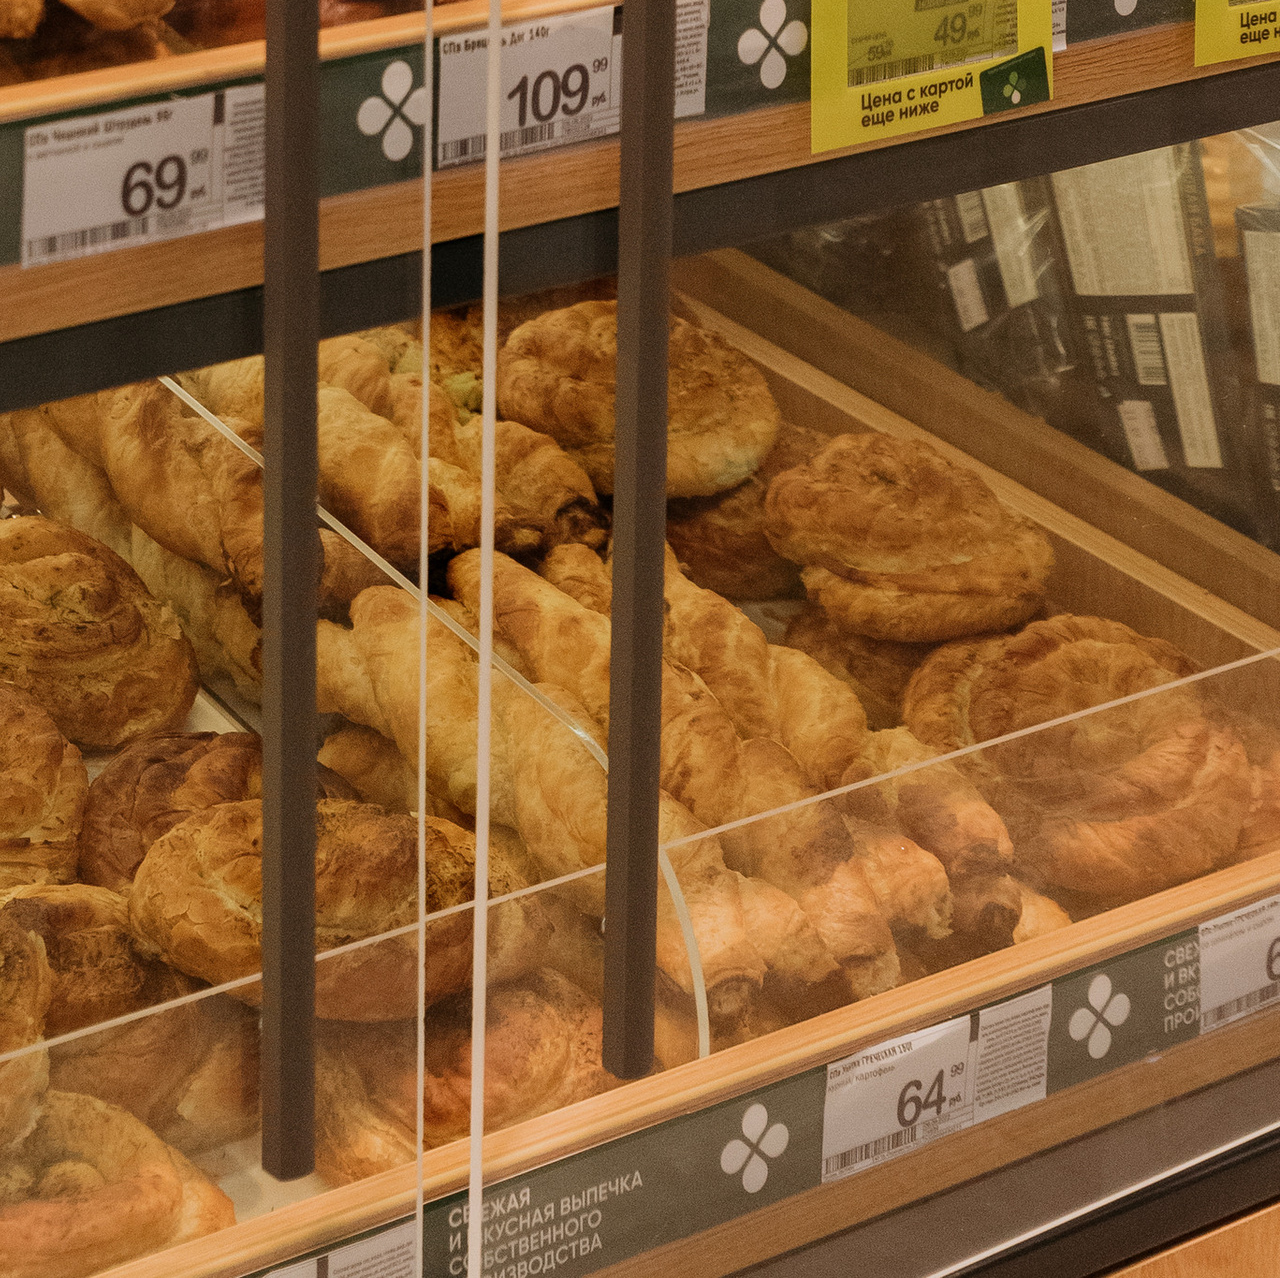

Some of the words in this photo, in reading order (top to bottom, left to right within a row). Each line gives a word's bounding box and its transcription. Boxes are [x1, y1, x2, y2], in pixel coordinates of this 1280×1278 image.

[934, 11, 967, 46] 49
[1240, 11, 1277, 29] Цена
[1240, 28, 1270, 44] еще
[592, 56, 608, 73] 99
[507, 63, 590, 127] 109
[861, 89, 902, 111] Цена
[907, 87, 915, 100] с
[920, 72, 974, 98] картой
[861, 111, 895, 128] еще
[899, 99, 940, 120] ниже
[120, 154, 188, 217] 69
[1164, 972, 1175, 990] И
[950, 1061, 964, 1078] 99
[897, 1069, 946, 1128] 64
[449, 1233, 461, 1253] И
[477, 1202, 555, 1246] КУСНАЯ
[560, 1170, 643, 1216] ВЫПЕЧКА
